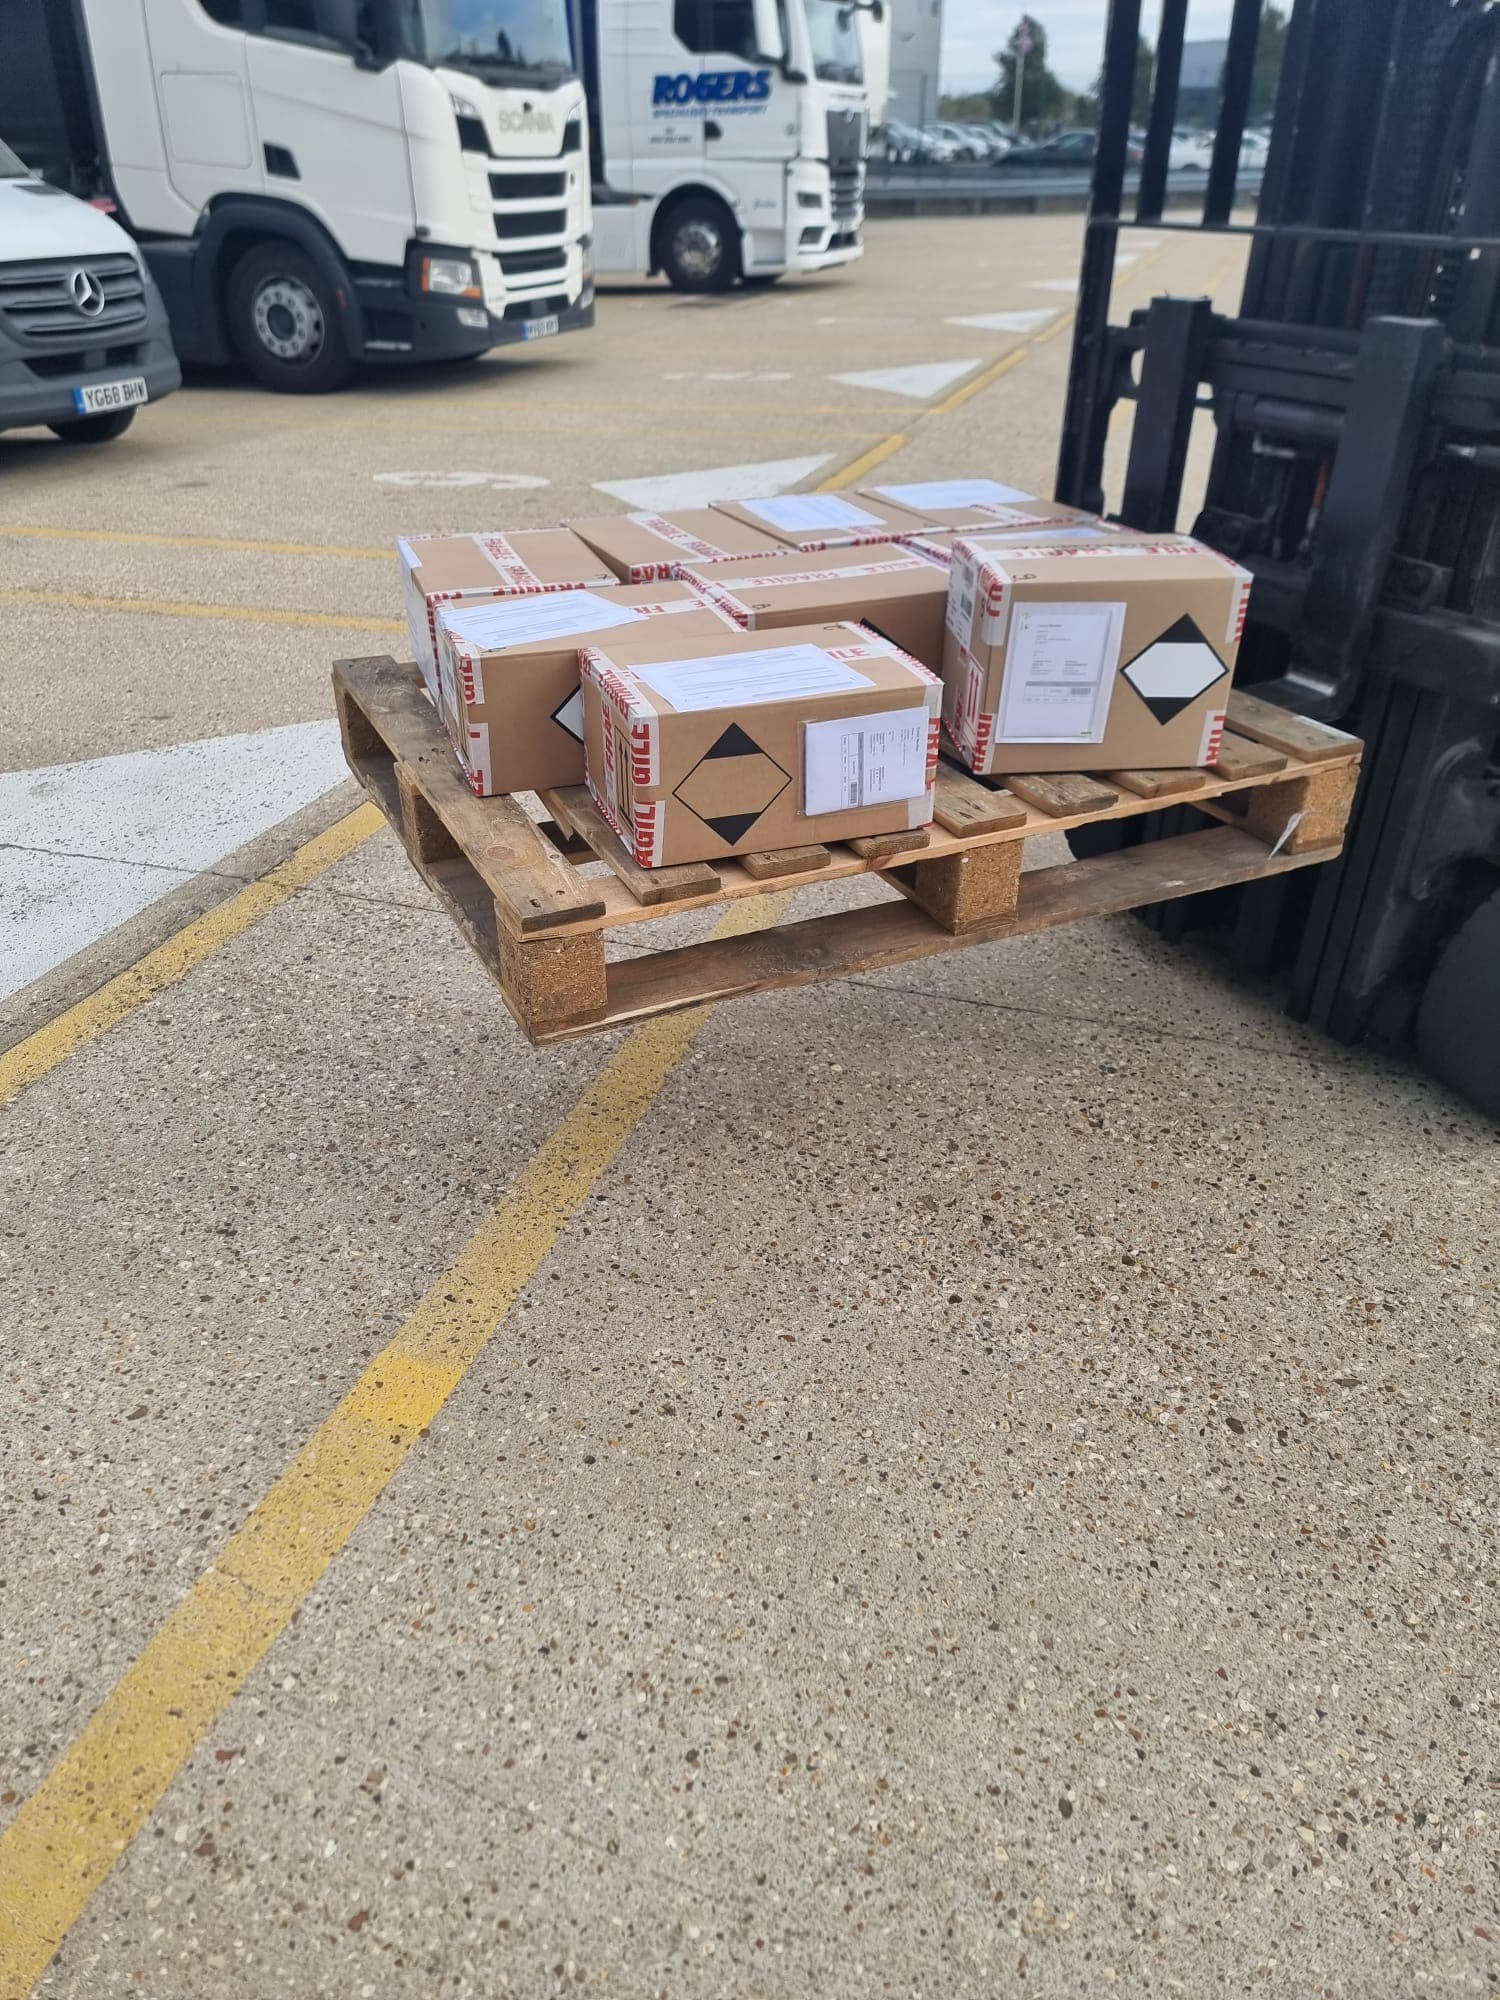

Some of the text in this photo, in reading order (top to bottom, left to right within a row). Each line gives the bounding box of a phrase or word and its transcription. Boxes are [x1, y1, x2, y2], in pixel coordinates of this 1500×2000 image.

[653, 70, 771, 104] ROGERS
[499, 109, 555, 133] SCANIA
[85, 385, 121, 408] YG68
